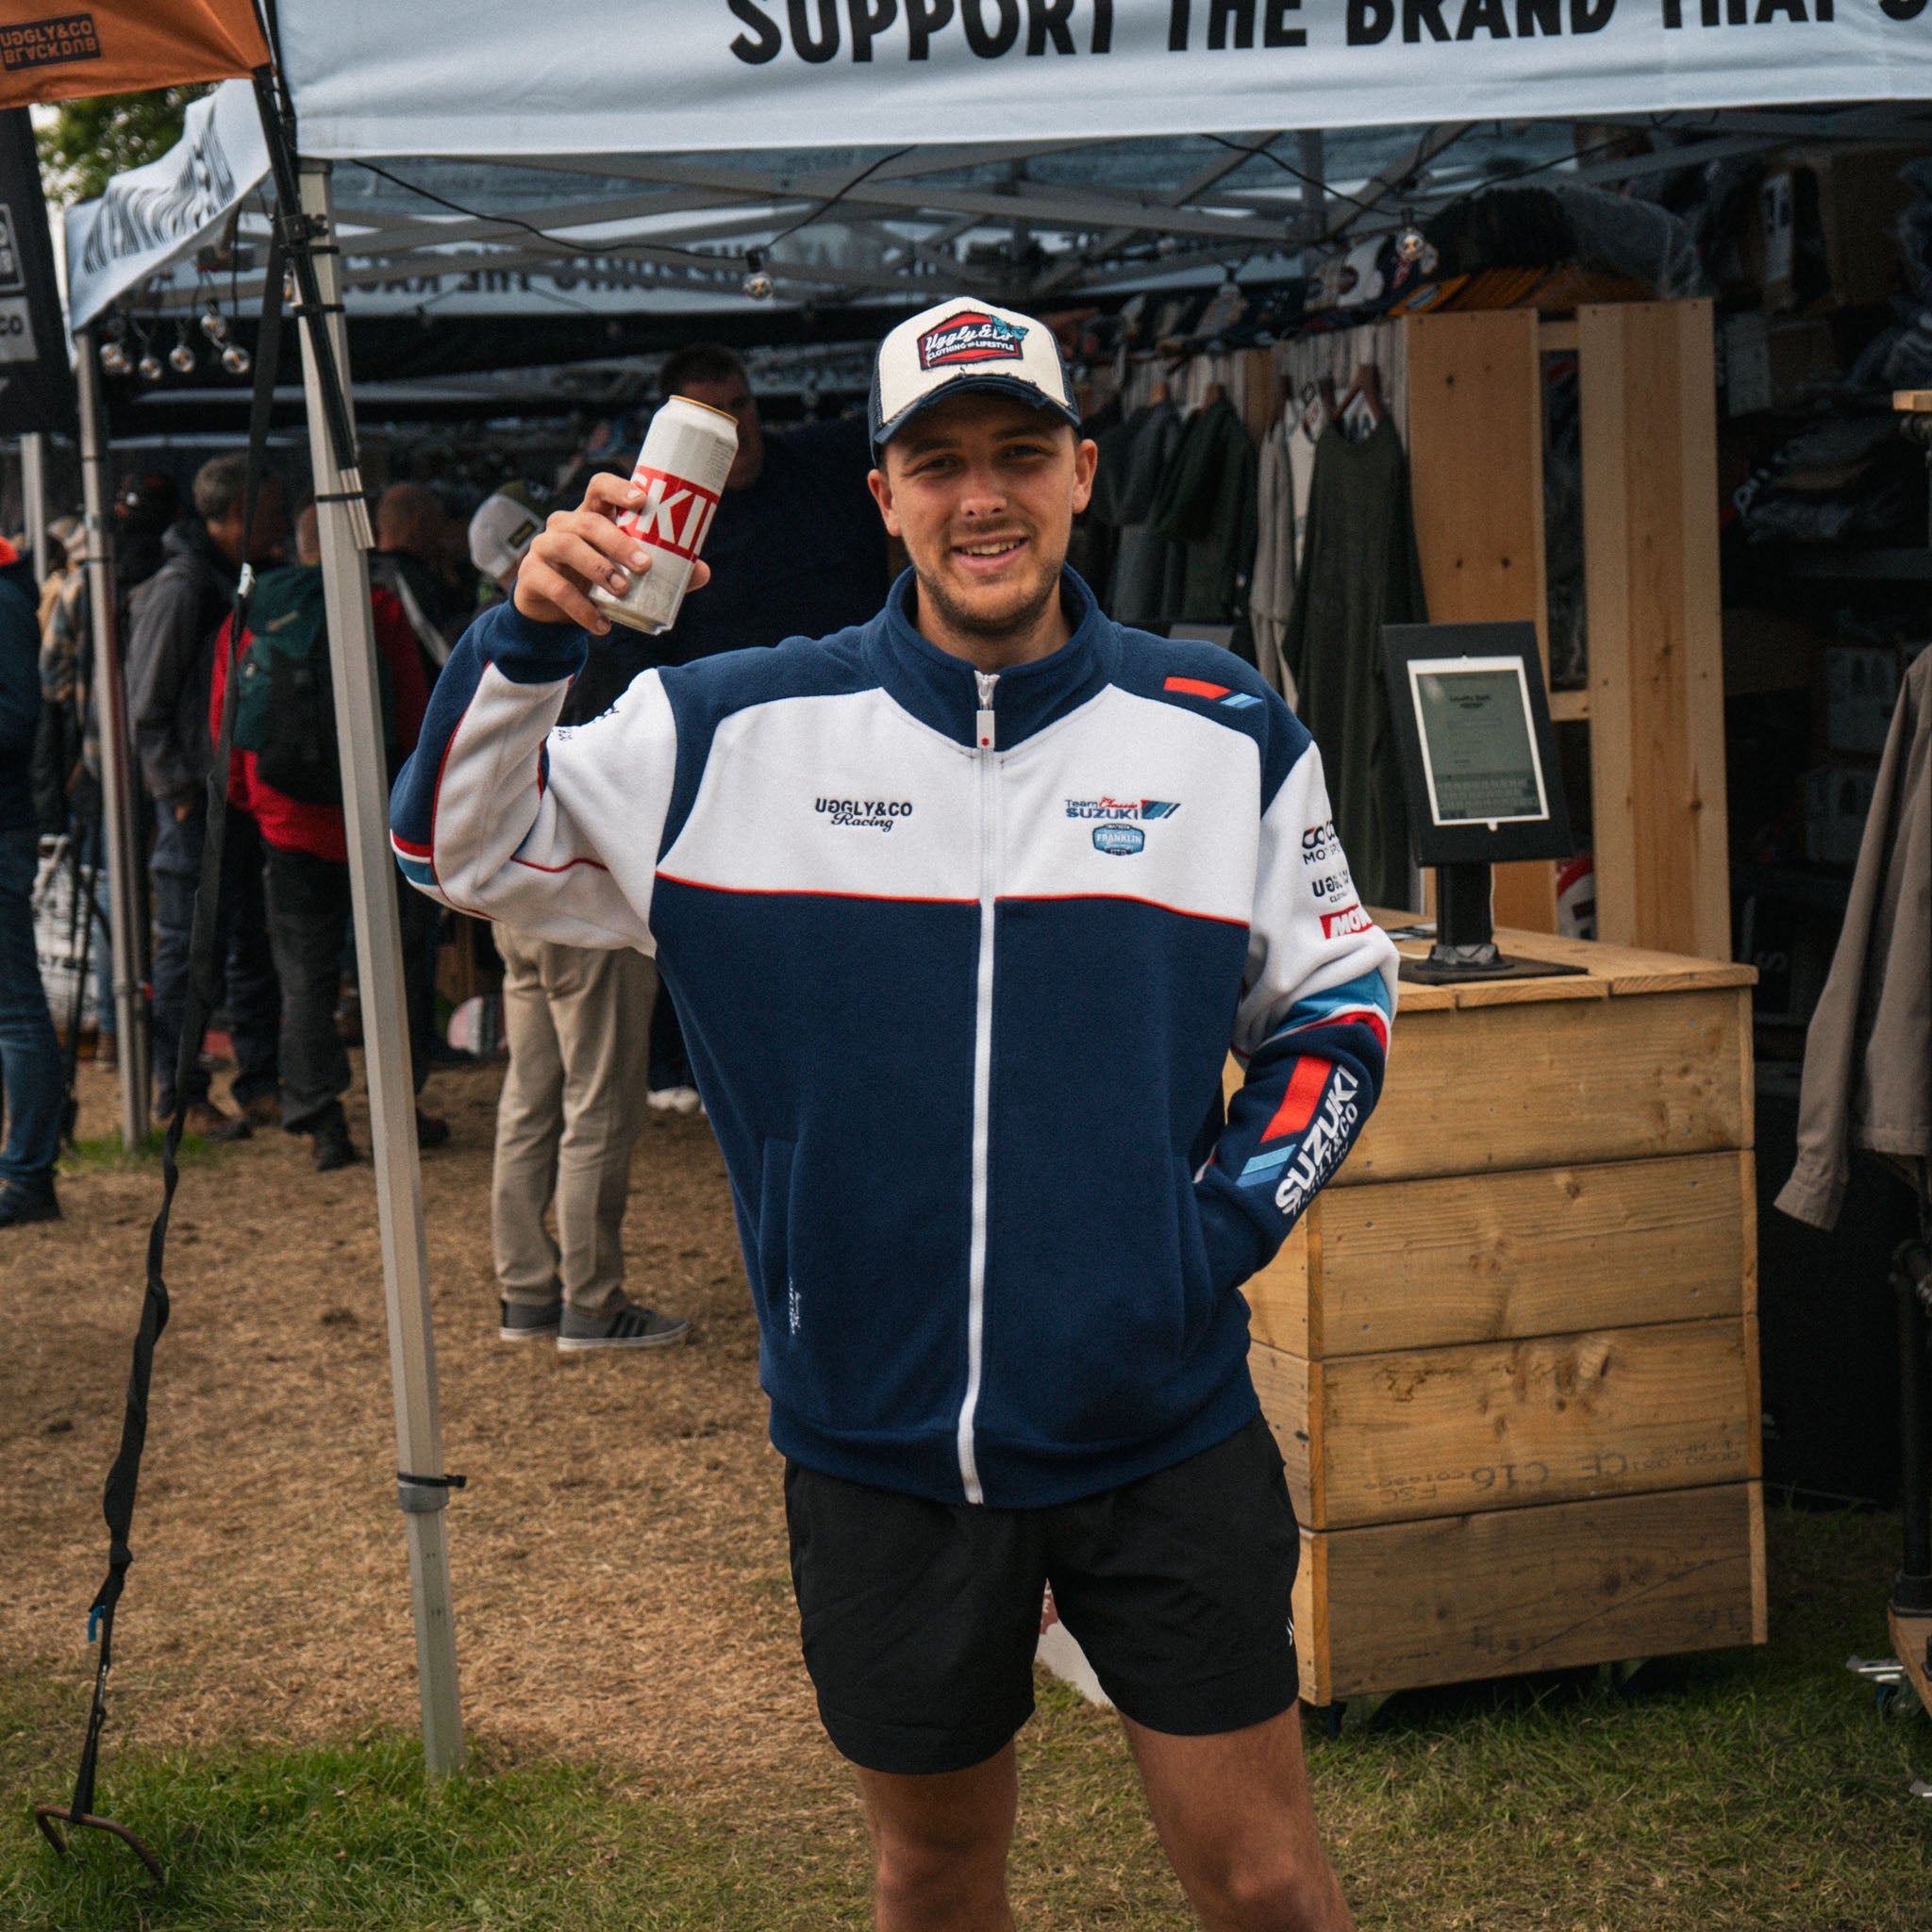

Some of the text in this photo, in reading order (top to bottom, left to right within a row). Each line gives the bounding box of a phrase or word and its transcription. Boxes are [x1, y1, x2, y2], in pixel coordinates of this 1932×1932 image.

[727, 0, 1113, 64] SUPPORT
[1168, 0, 1308, 51] THE
[927, 342, 967, 359] CLOTHING
[814, 797, 913, 817] UGGLY&CO
[1065, 799, 1098, 808] Team
[830, 811, 894, 833] Racing
[1065, 808, 1139, 820] SUZUKI
[1096, 833, 1142, 844] FRANKLIN
[1275, 1064, 1358, 1215] SUZUKI
[1380, 1484, 1438, 1506] FSC
